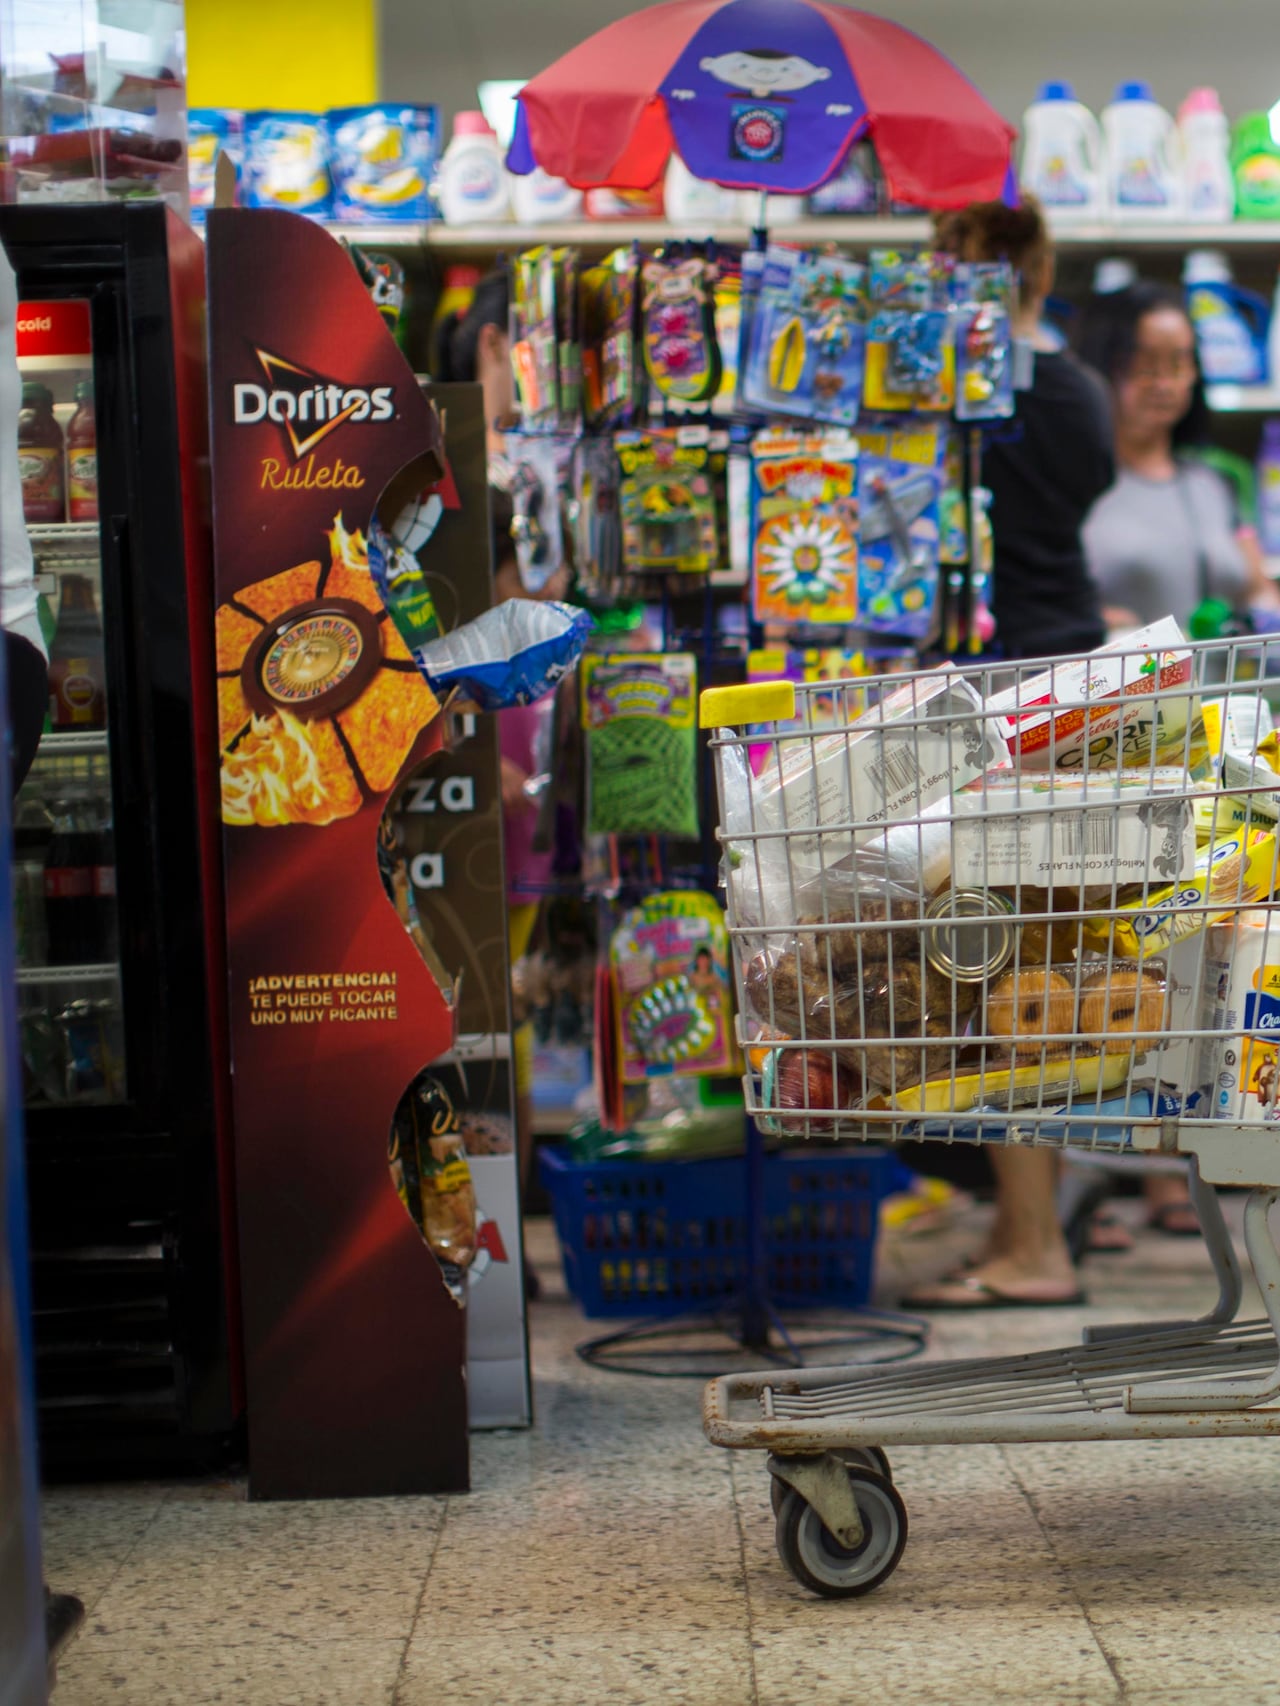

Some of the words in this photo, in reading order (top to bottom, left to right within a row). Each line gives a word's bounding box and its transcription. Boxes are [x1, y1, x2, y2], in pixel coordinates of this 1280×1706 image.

[233, 383, 395, 424] Doritos
[260, 453, 366, 490] Ruleta
[249, 972, 397, 993] ¡ADVERTENCIA!
[250, 993, 272, 1008] TE
[276, 992, 333, 1008] PUEDE
[338, 990, 396, 1005] TOCAR
[251, 1010, 287, 1025] UNO
[290, 1010, 325, 1024] MUY
[329, 1006, 397, 1022] PICANTE
